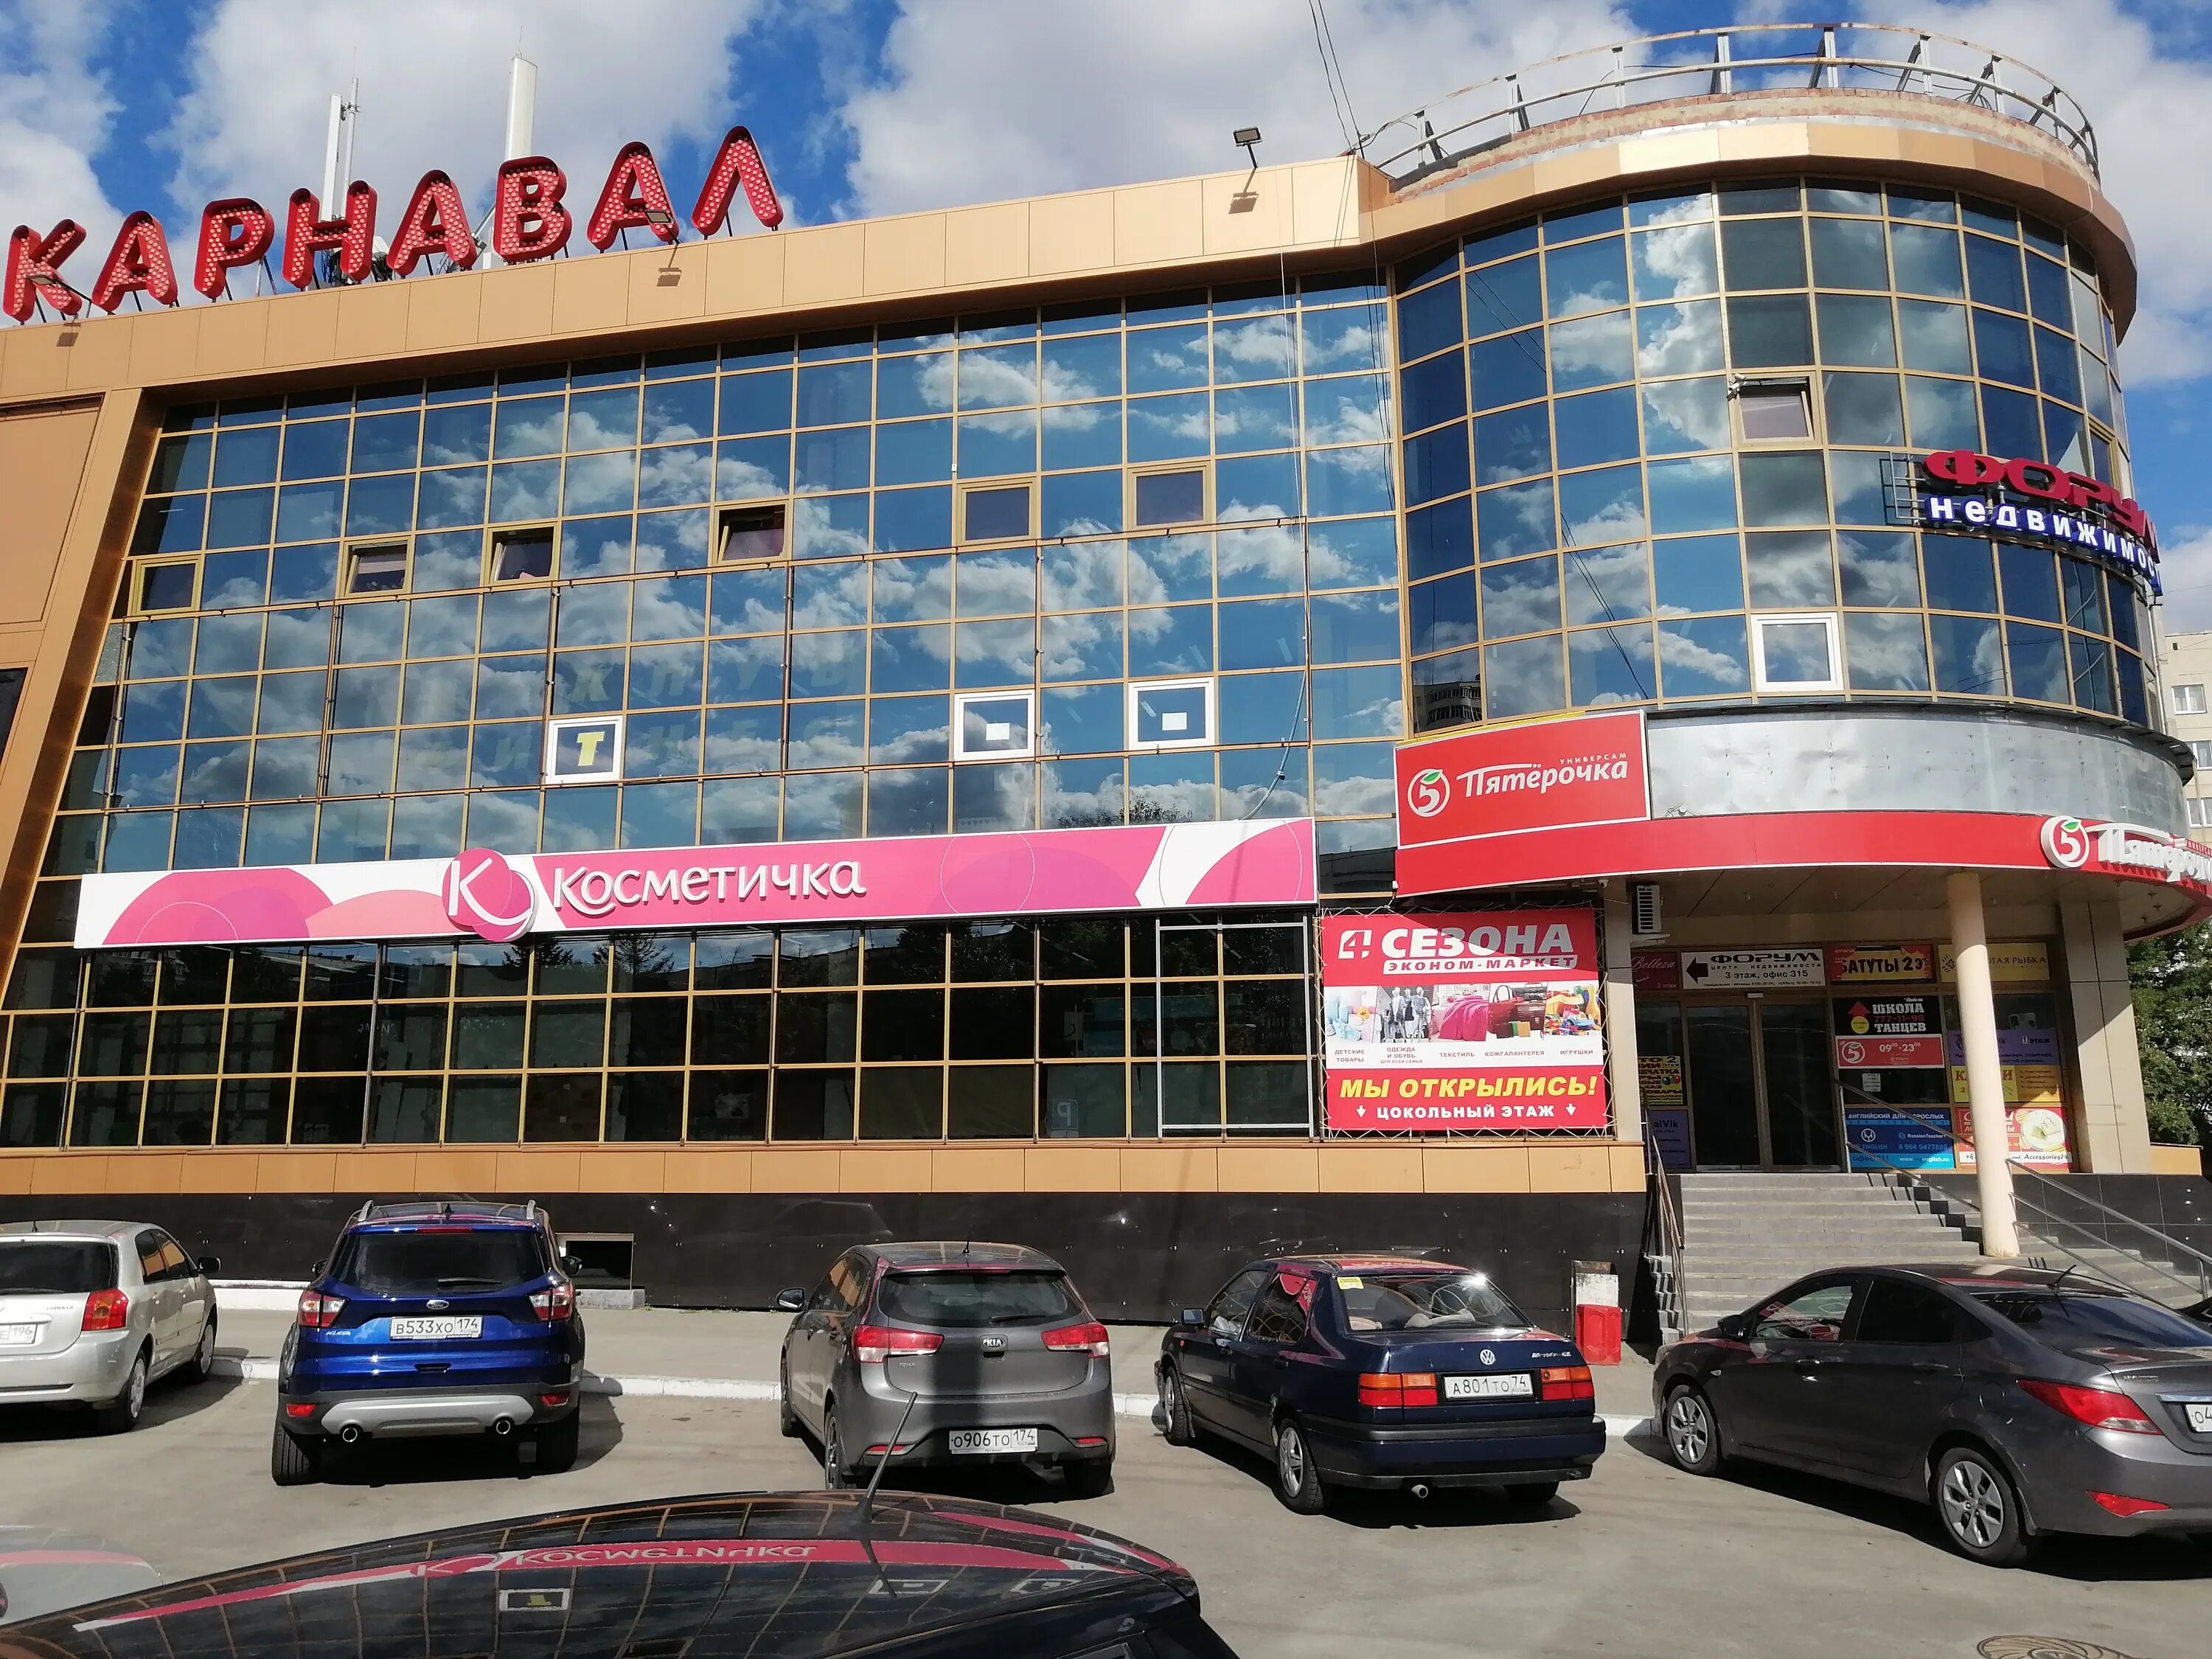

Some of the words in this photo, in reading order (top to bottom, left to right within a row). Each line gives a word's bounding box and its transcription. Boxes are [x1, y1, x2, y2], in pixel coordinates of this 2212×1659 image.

[2, 125, 784, 321] КАРНАВАЛ
[1560, 752, 1627, 765] УНИВЕРСАМ
[1456, 760, 1628, 797] Пятёрочка
[554, 860, 867, 915] Косметичка
[1338, 929, 1372, 959] 4
[1381, 924, 1574, 959] СЕЗОНА
[1632, 956, 1675, 972] Belleza
[1711, 952, 1820, 964] ФОРУМ
[1763, 970, 1788, 979] офис
[1872, 1003, 1924, 1014] ШКОЛА
[1874, 1023, 1927, 1033] ТАНЦЕВ
[1340, 1079, 1389, 1098] МЫ
[1399, 1077, 1598, 1099] ОТКРЫЛИСЬ!
[1377, 1105, 1495, 1119] ЦОКОЛЬНЫЙ
[1501, 1105, 1554, 1118] ЭТАЖ
[457, 1318, 478, 1329] 174
[987, 1338, 1001, 1346] KIA
[1512, 1376, 1526, 1388] 74
[1013, 1429, 1035, 1441] 174
